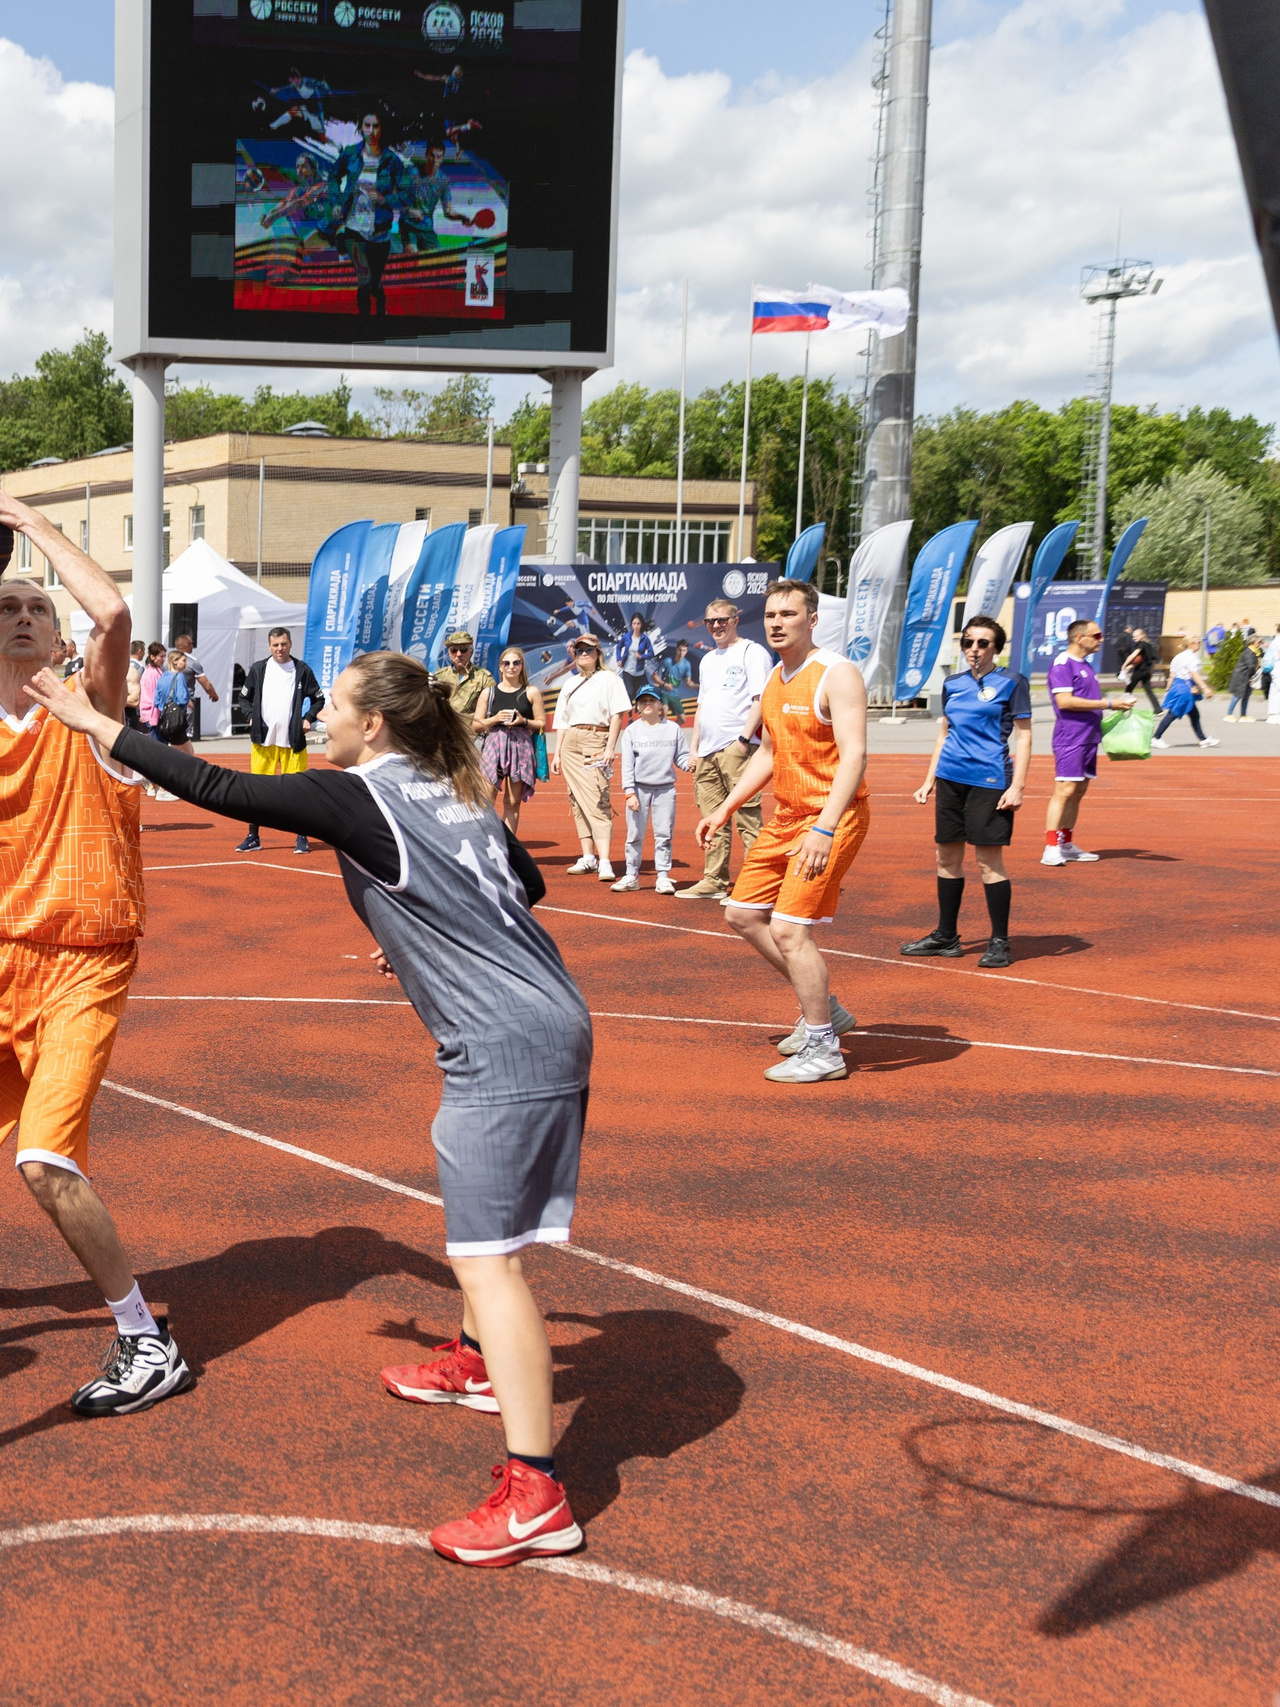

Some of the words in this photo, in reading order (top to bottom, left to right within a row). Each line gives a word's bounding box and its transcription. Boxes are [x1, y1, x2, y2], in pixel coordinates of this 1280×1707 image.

[274, 0, 318, 14] РОССЕТИ
[358, 6, 401, 21] РОССЕТИ
[470, 10, 504, 28] ПСКОВ
[588, 571, 688, 593] СПАРТАКИАДА
[746, 572, 769, 582] ПСКОВ
[746, 581, 768, 595] 2025
[922, 566, 944, 622] СПАРТАКИАДА
[325, 570, 341, 632] СПАРТАКИАДА
[362, 583, 378, 644] СЕВЕРО-ЗАПАД
[411, 584, 432, 641] РОССЕТИ
[424, 583, 445, 639] СЕВЕРО-ЗАПАД
[597, 594, 606, 604] ПО
[606, 593, 631, 604] ЛЕТНИМ
[632, 593, 654, 604] ВИДАМ
[654, 592, 678, 603] СПОРТА
[854, 578, 872, 633] РОССЕТИ
[981, 579, 997, 614] СЕТИ
[322, 645, 333, 687] РОССЕТИ
[908, 632, 925, 668] РОССЕТИ
[634, 740, 677, 748] CHAMPIONS
